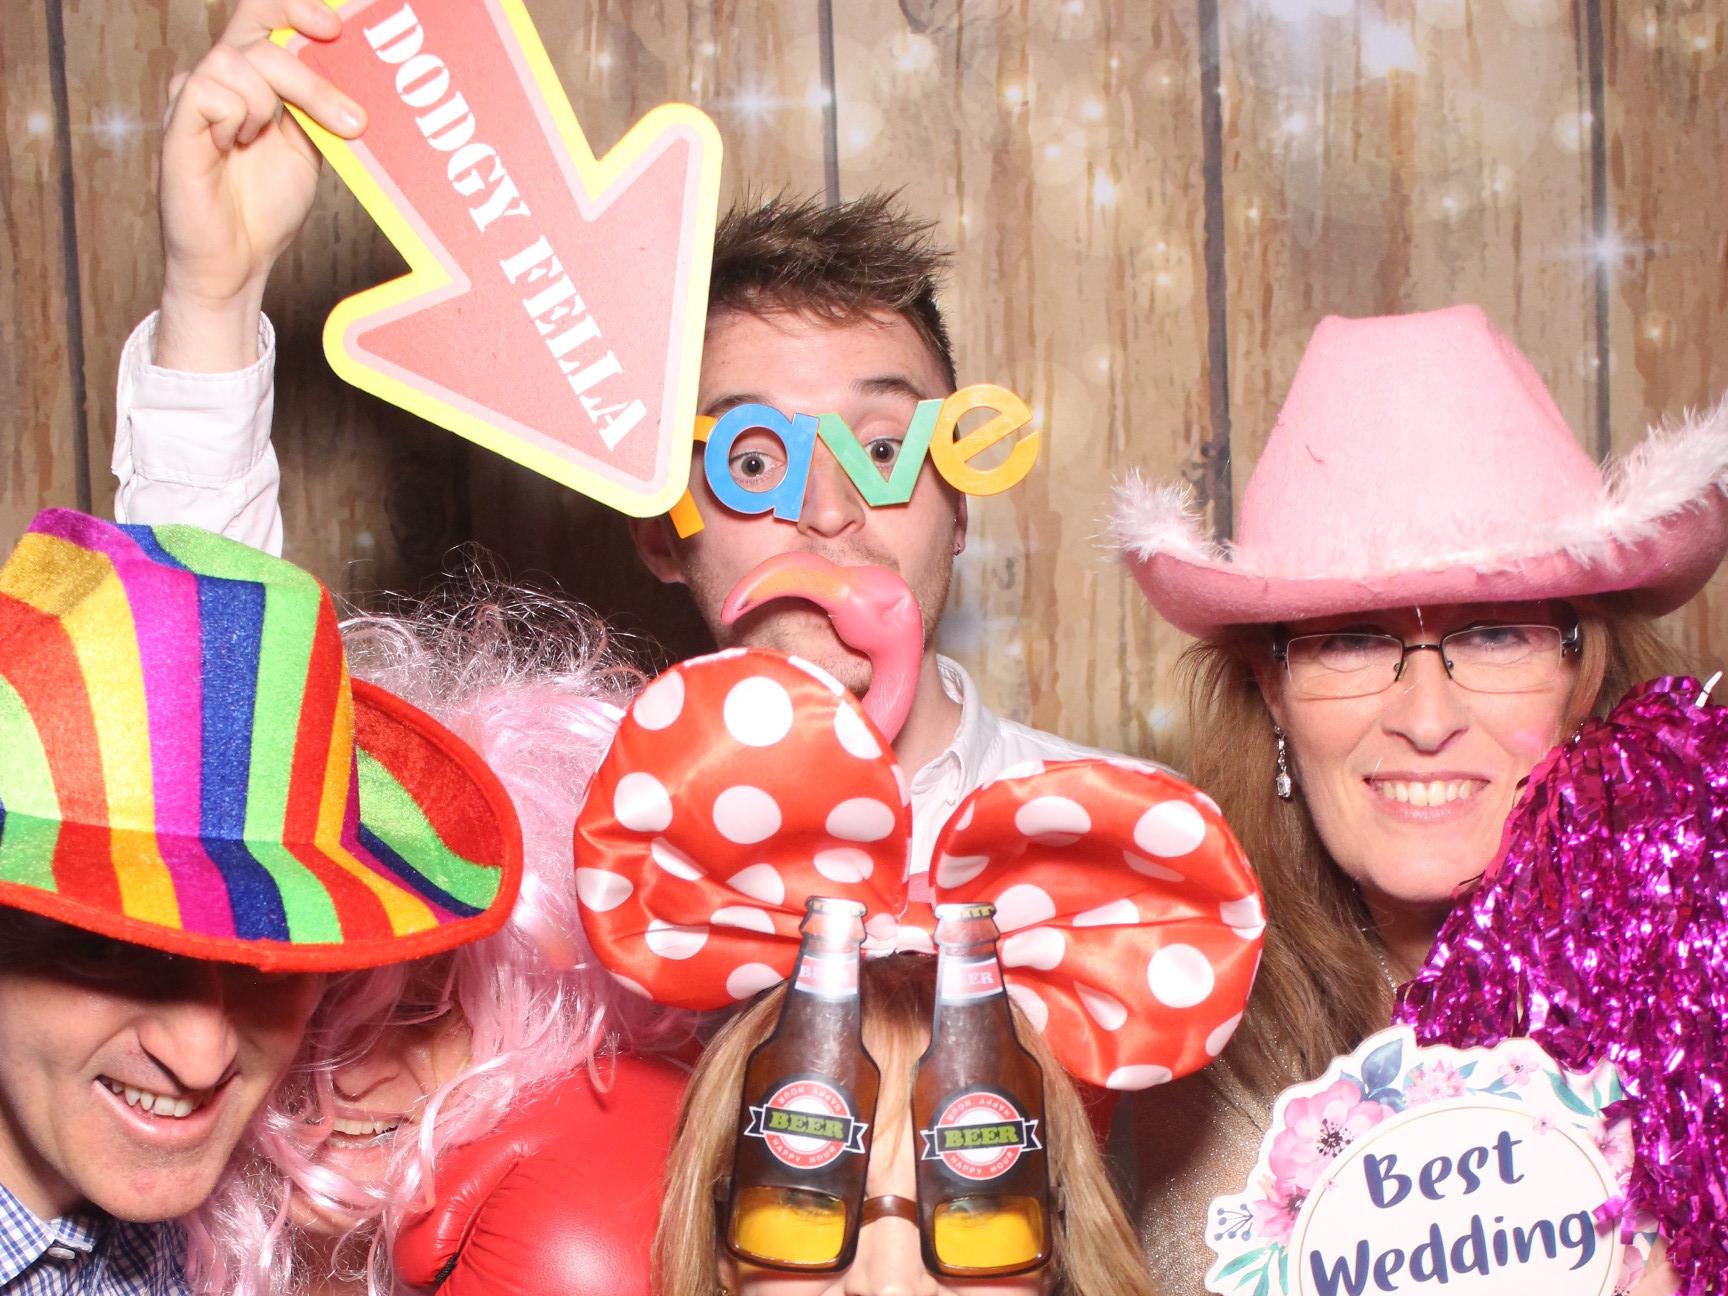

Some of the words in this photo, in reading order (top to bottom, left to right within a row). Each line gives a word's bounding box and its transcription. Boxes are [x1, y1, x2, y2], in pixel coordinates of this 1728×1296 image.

[362, 4, 532, 233] DODGY
[499, 234, 647, 452] FELLA
[769, 1111, 844, 1140] BEER
[943, 1125, 1020, 1149] BEER
[771, 1138, 801, 1163] HAPPY
[809, 1145, 837, 1164] HOUR
[950, 1155, 983, 1175] HAPPY
[990, 1150, 1015, 1173] HOUR
[1363, 1131, 1526, 1209] Best
